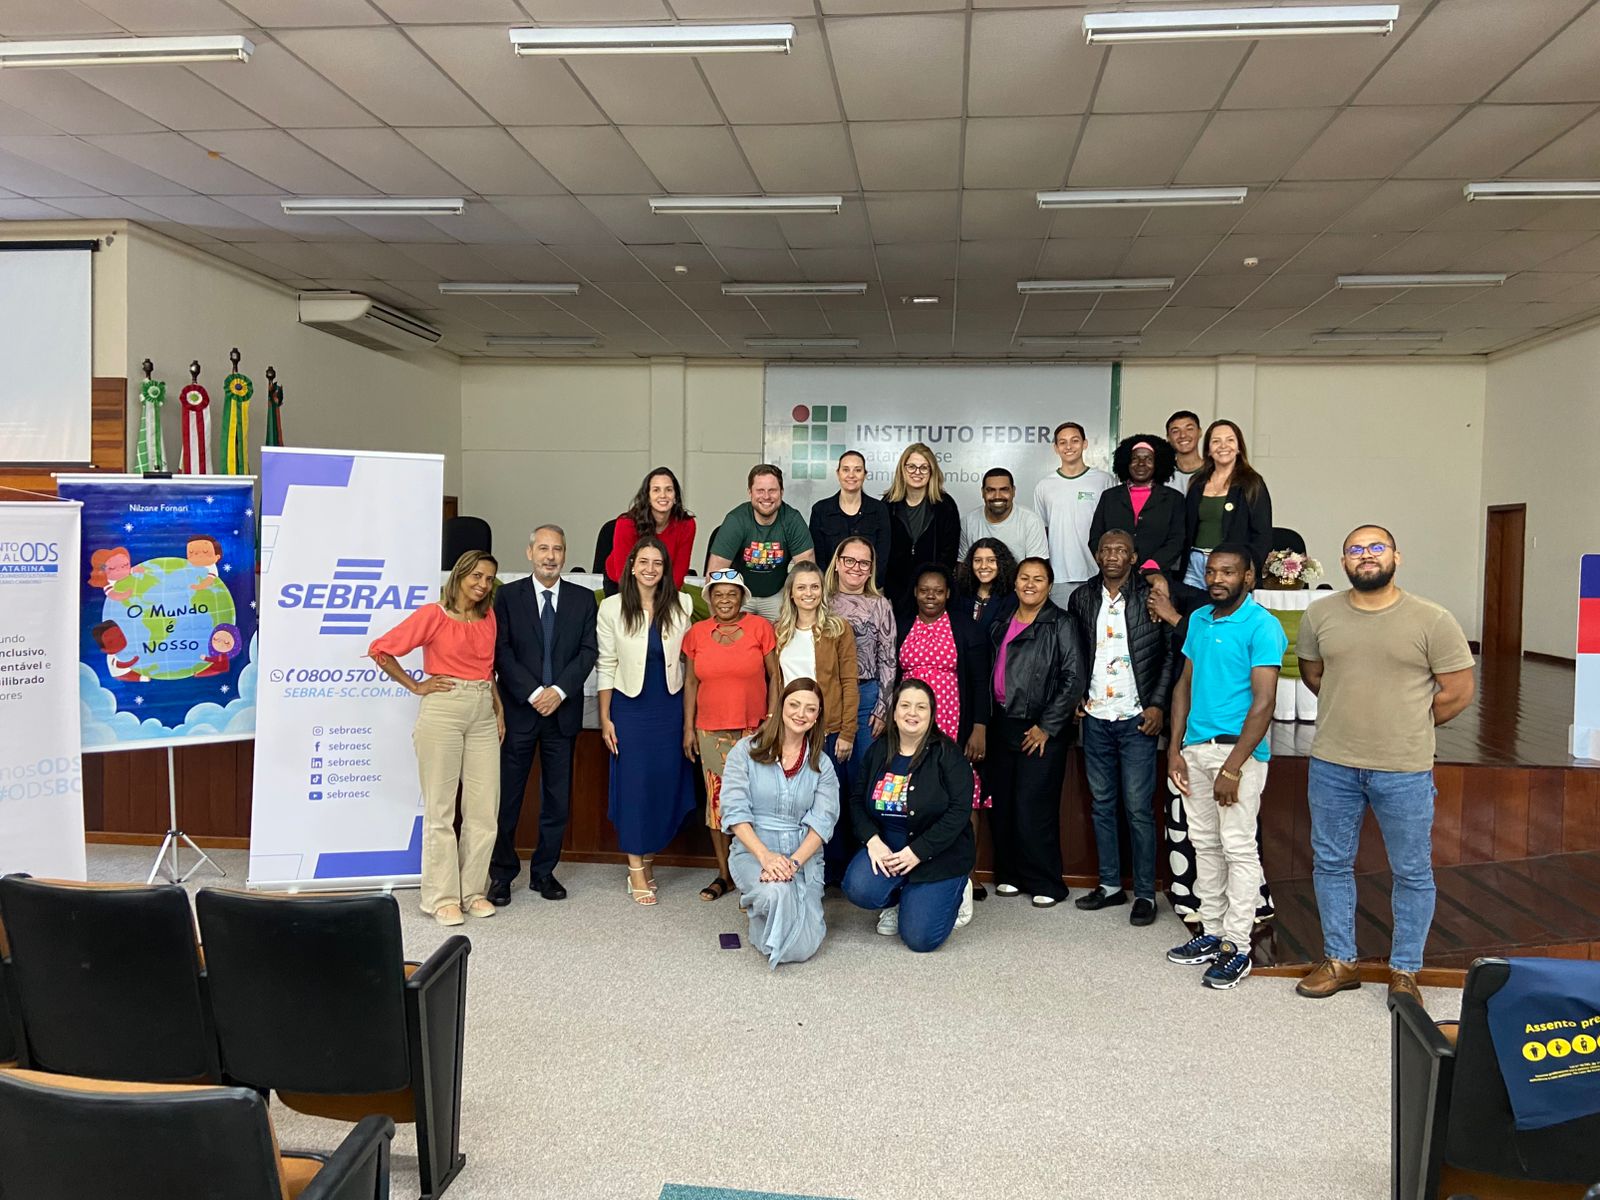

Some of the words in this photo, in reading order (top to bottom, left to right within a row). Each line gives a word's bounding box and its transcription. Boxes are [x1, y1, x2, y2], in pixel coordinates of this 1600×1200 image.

[857, 425, 974, 443] INSTITUTO
[982, 426, 1055, 443] FEDER
[129, 504, 159, 512] Nilzane
[160, 504, 189, 512] Fornari
[20, 542, 59, 562] ODS
[277, 583, 429, 610] SEBRAE
[127, 605, 143, 618] O
[165, 620, 175, 633] é
[297, 669, 343, 682] 0800
[345, 669, 376, 682] 570
[283, 687, 411, 698] SEBRAE-SC.COM.BR
[328, 726, 372, 735] sebraesc
[328, 742, 372, 751] sebraesc
[327, 758, 371, 767] sebraesc
[327, 773, 382, 785] @sebraesc
[326, 790, 371, 799] sebraesc
[1525, 1020, 1577, 1034] Assento
